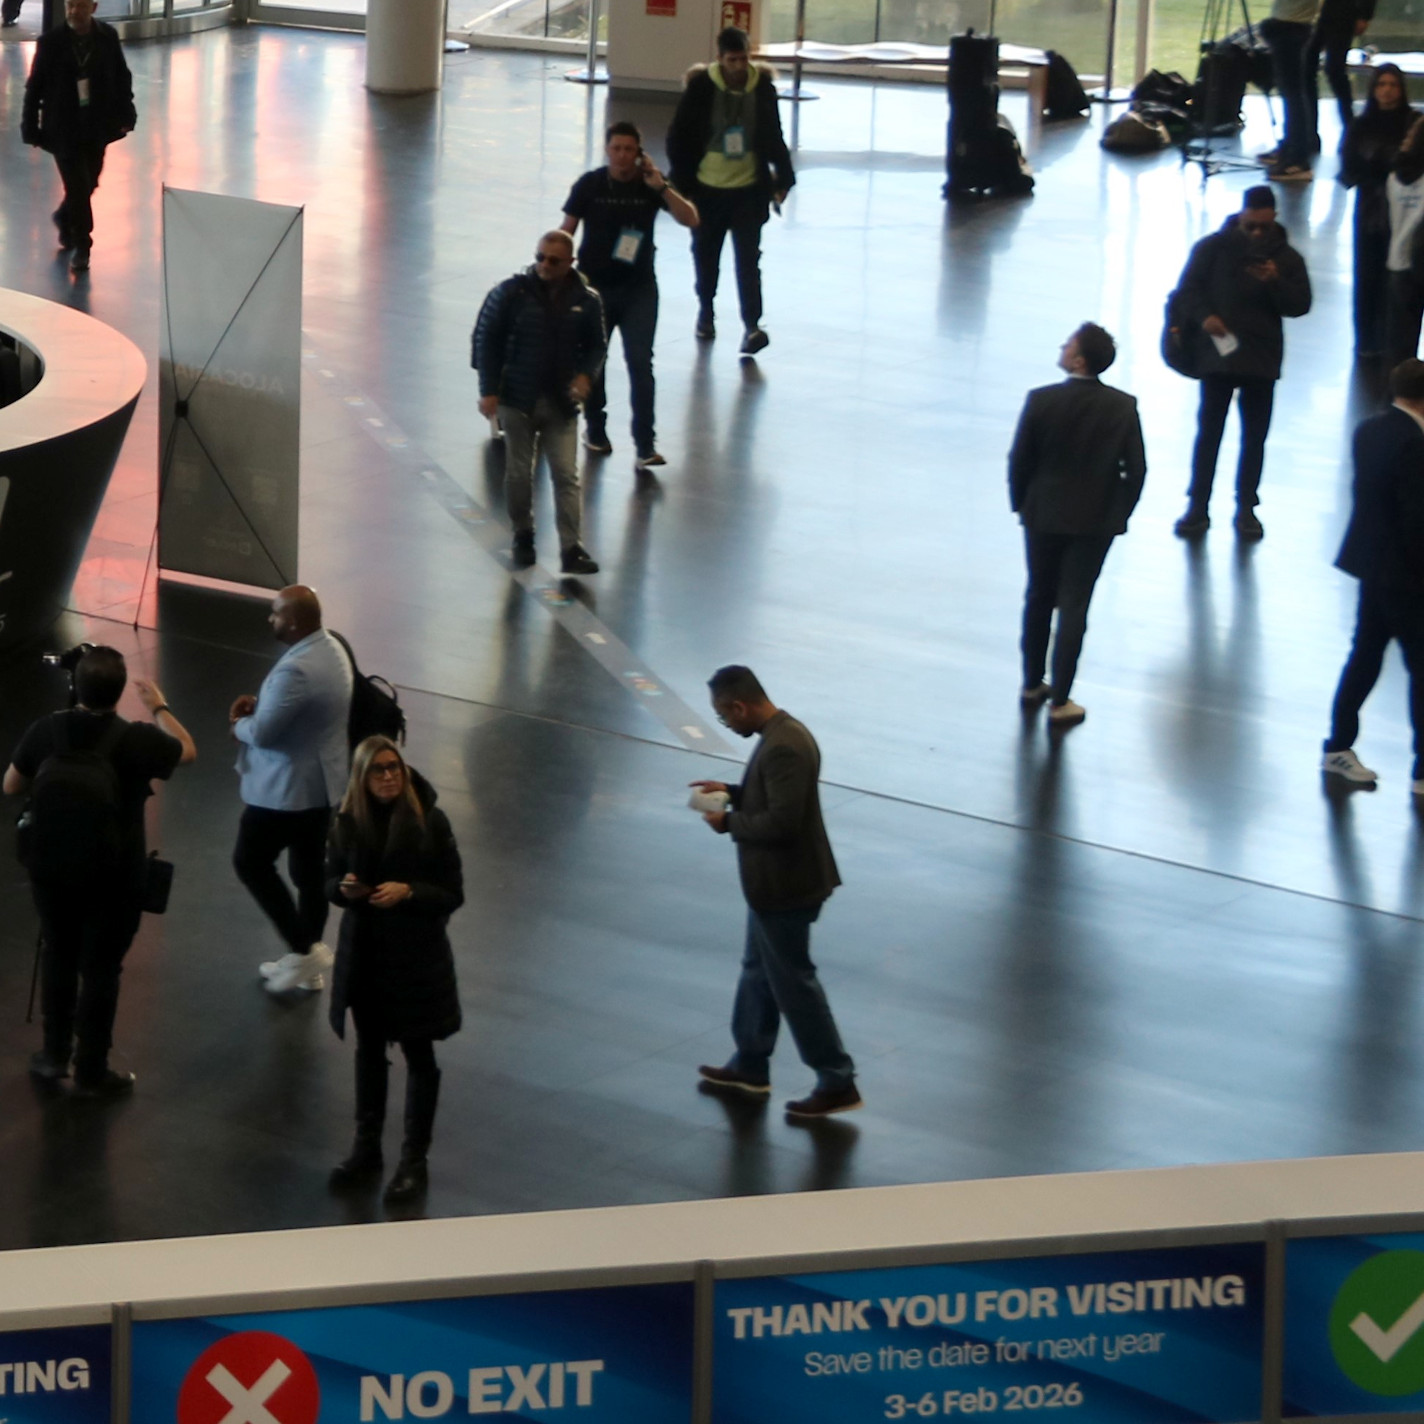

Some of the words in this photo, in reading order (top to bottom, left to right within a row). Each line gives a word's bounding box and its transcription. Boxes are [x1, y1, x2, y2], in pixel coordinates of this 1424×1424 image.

[727, 1299, 871, 1340] THANK
[879, 1291, 970, 1331] YOU
[975, 1286, 1058, 1322] FOR
[1064, 1273, 1246, 1317] VISITING
[803, 1349, 872, 1378] Save
[878, 1344, 924, 1371] the
[927, 1339, 990, 1368] date
[994, 1334, 1032, 1364] for
[1036, 1334, 1098, 1361] next
[1102, 1329, 1165, 1362] year
[359, 1369, 455, 1422] NO
[467, 1358, 605, 1414] EXIT
[884, 1391, 936, 1420] 3-6
[942, 1387, 998, 1416] Feb
[1002, 1381, 1084, 1412] 2026
